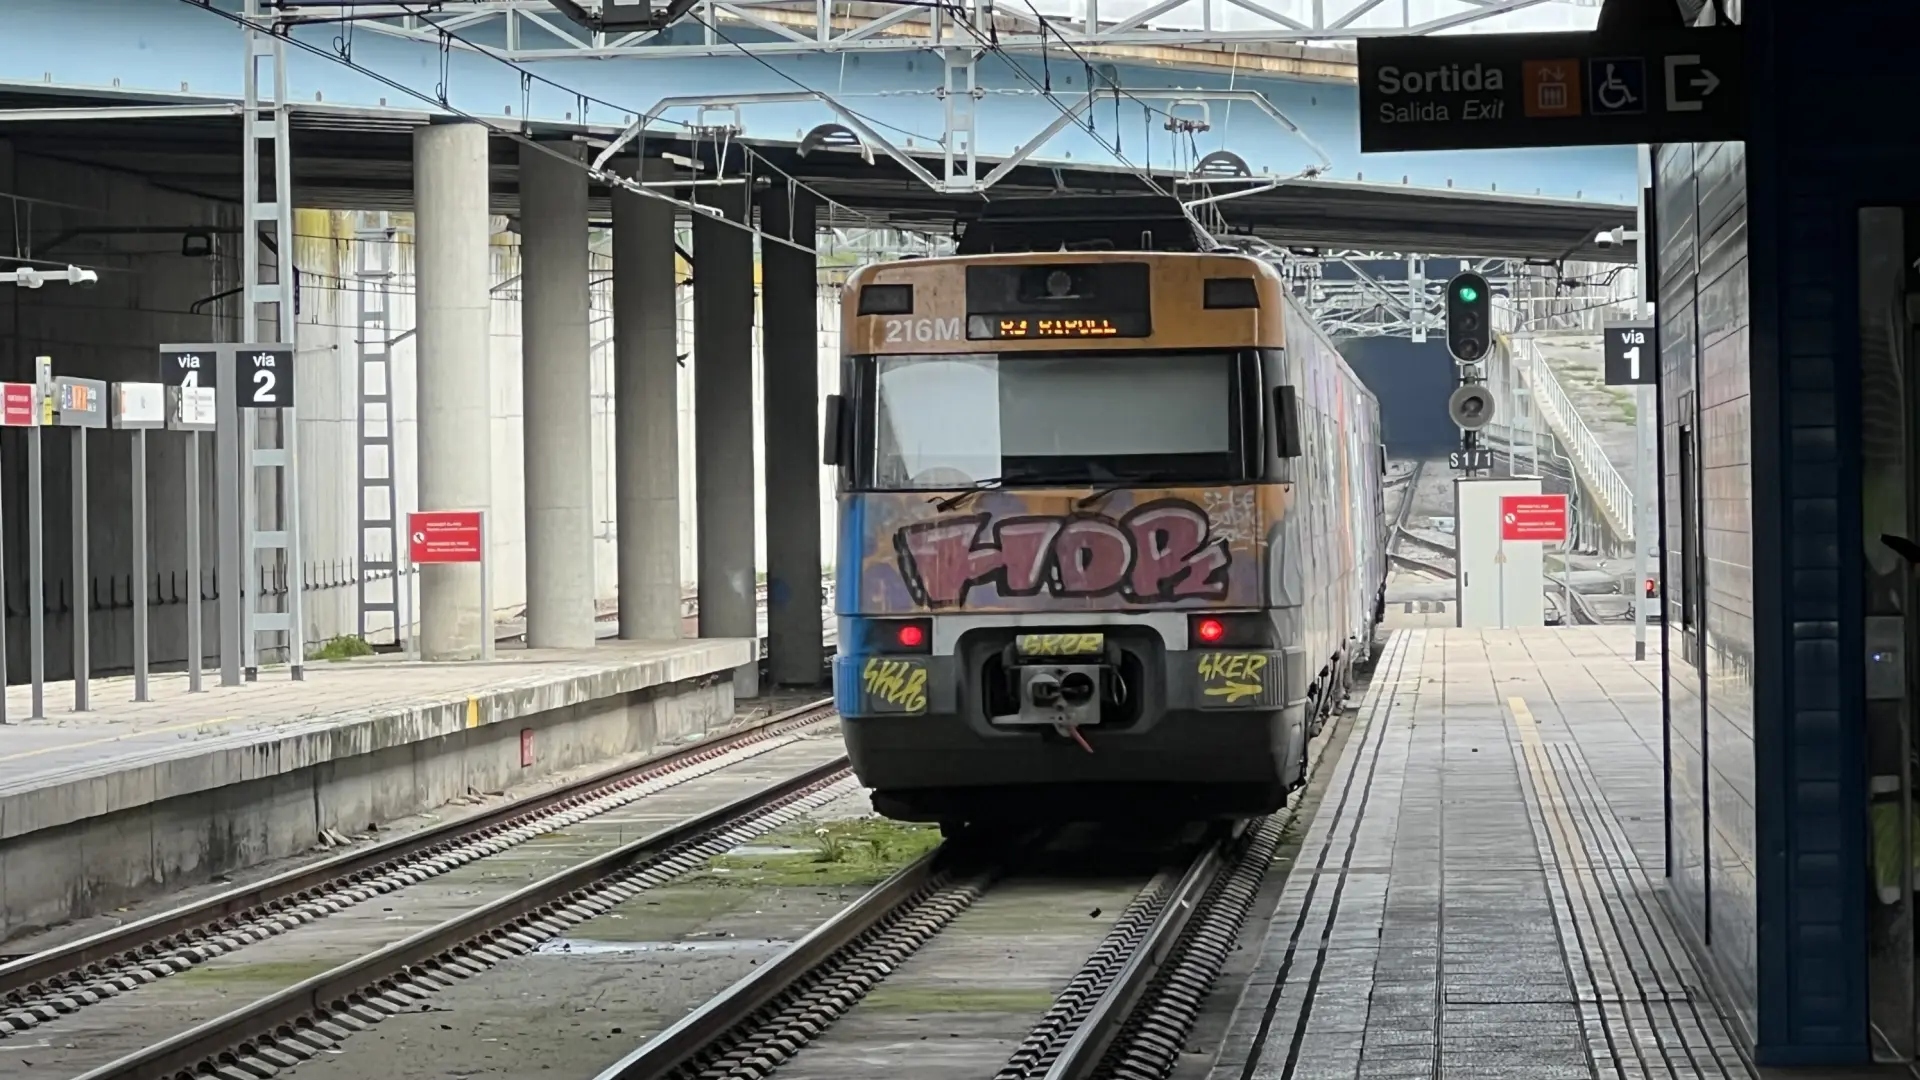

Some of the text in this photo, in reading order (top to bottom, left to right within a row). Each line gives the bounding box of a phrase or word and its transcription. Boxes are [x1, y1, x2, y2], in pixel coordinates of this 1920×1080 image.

[1378, 63, 1503, 94] Sortida
[1380, 98, 1504, 123] Salida Exit
[886, 318, 960, 342] 216M
[1621, 329, 1645, 345] via
[177, 354, 200, 368] via
[253, 352, 276, 367] via
[1623, 347, 1640, 380] 1
[253, 369, 276, 402] 2
